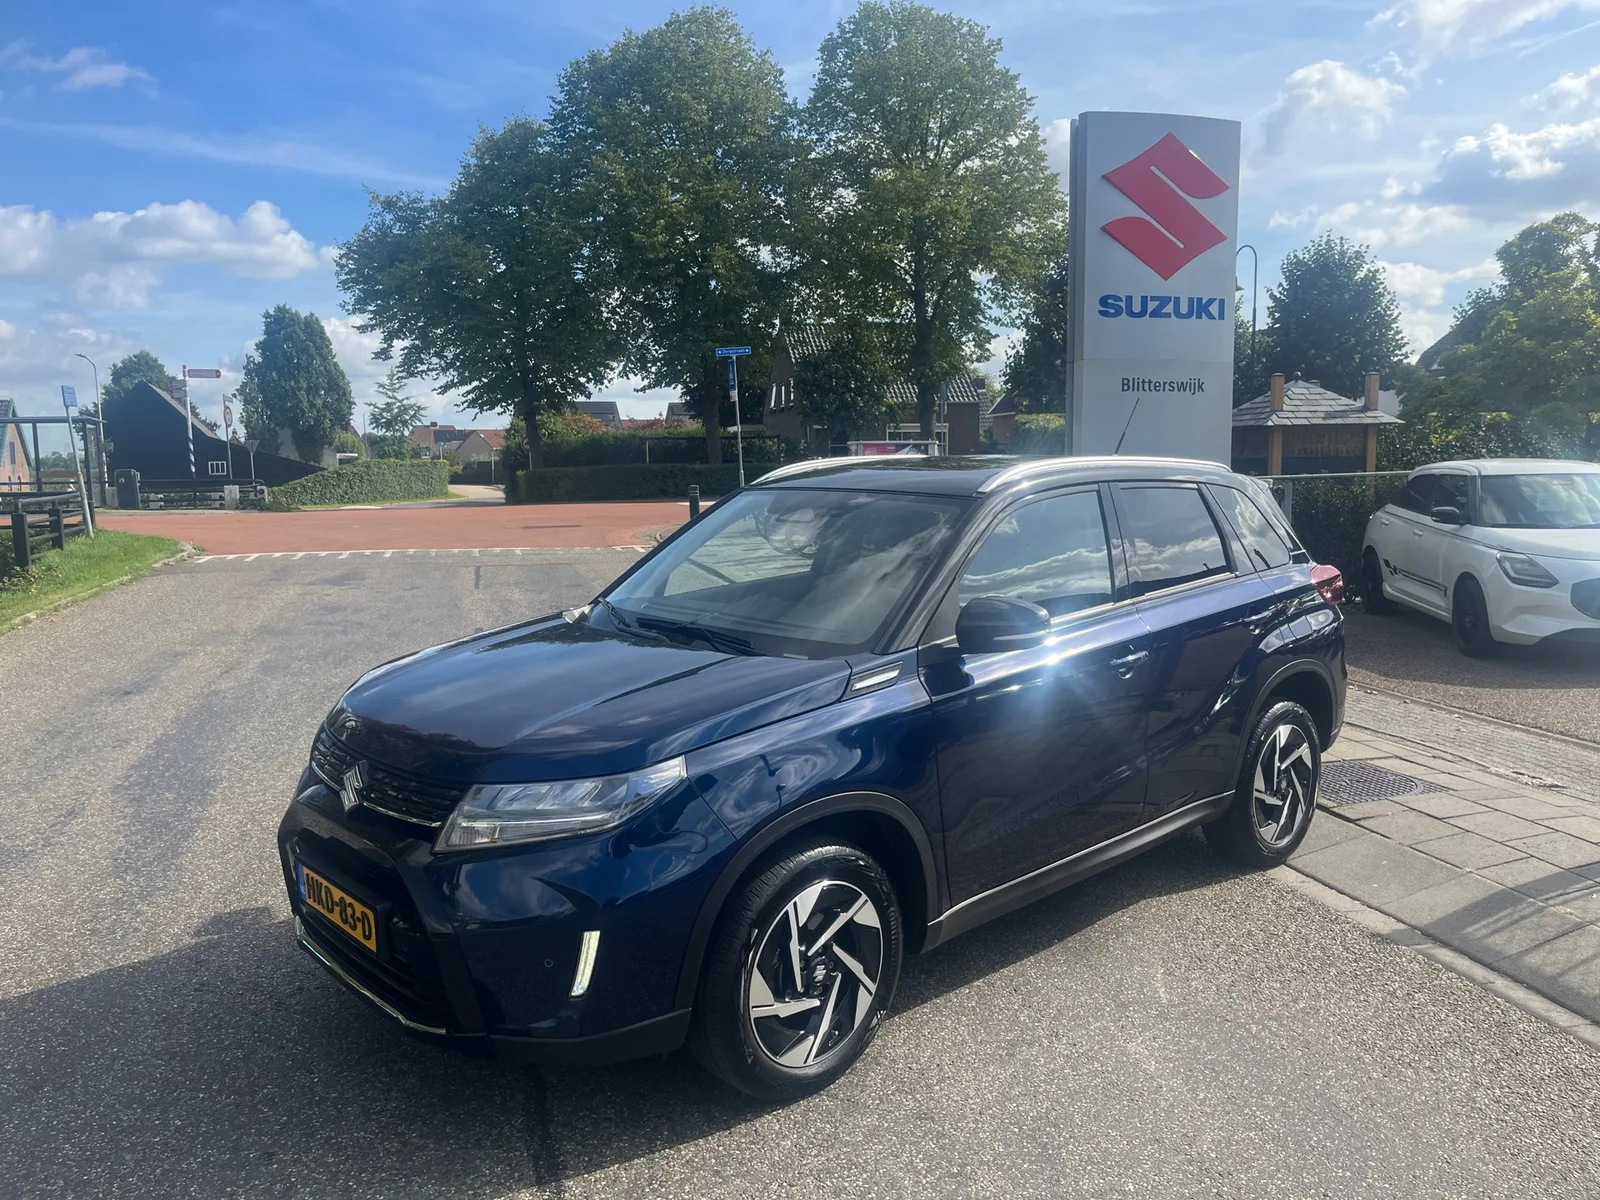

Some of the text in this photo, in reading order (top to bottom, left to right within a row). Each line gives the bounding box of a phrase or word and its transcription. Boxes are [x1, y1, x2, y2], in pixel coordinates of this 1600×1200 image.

[1098, 294, 1226, 320] SUZUKI
[1121, 377, 1205, 395] Blitterswijk
[306, 873, 372, 941] HKD-83-D
